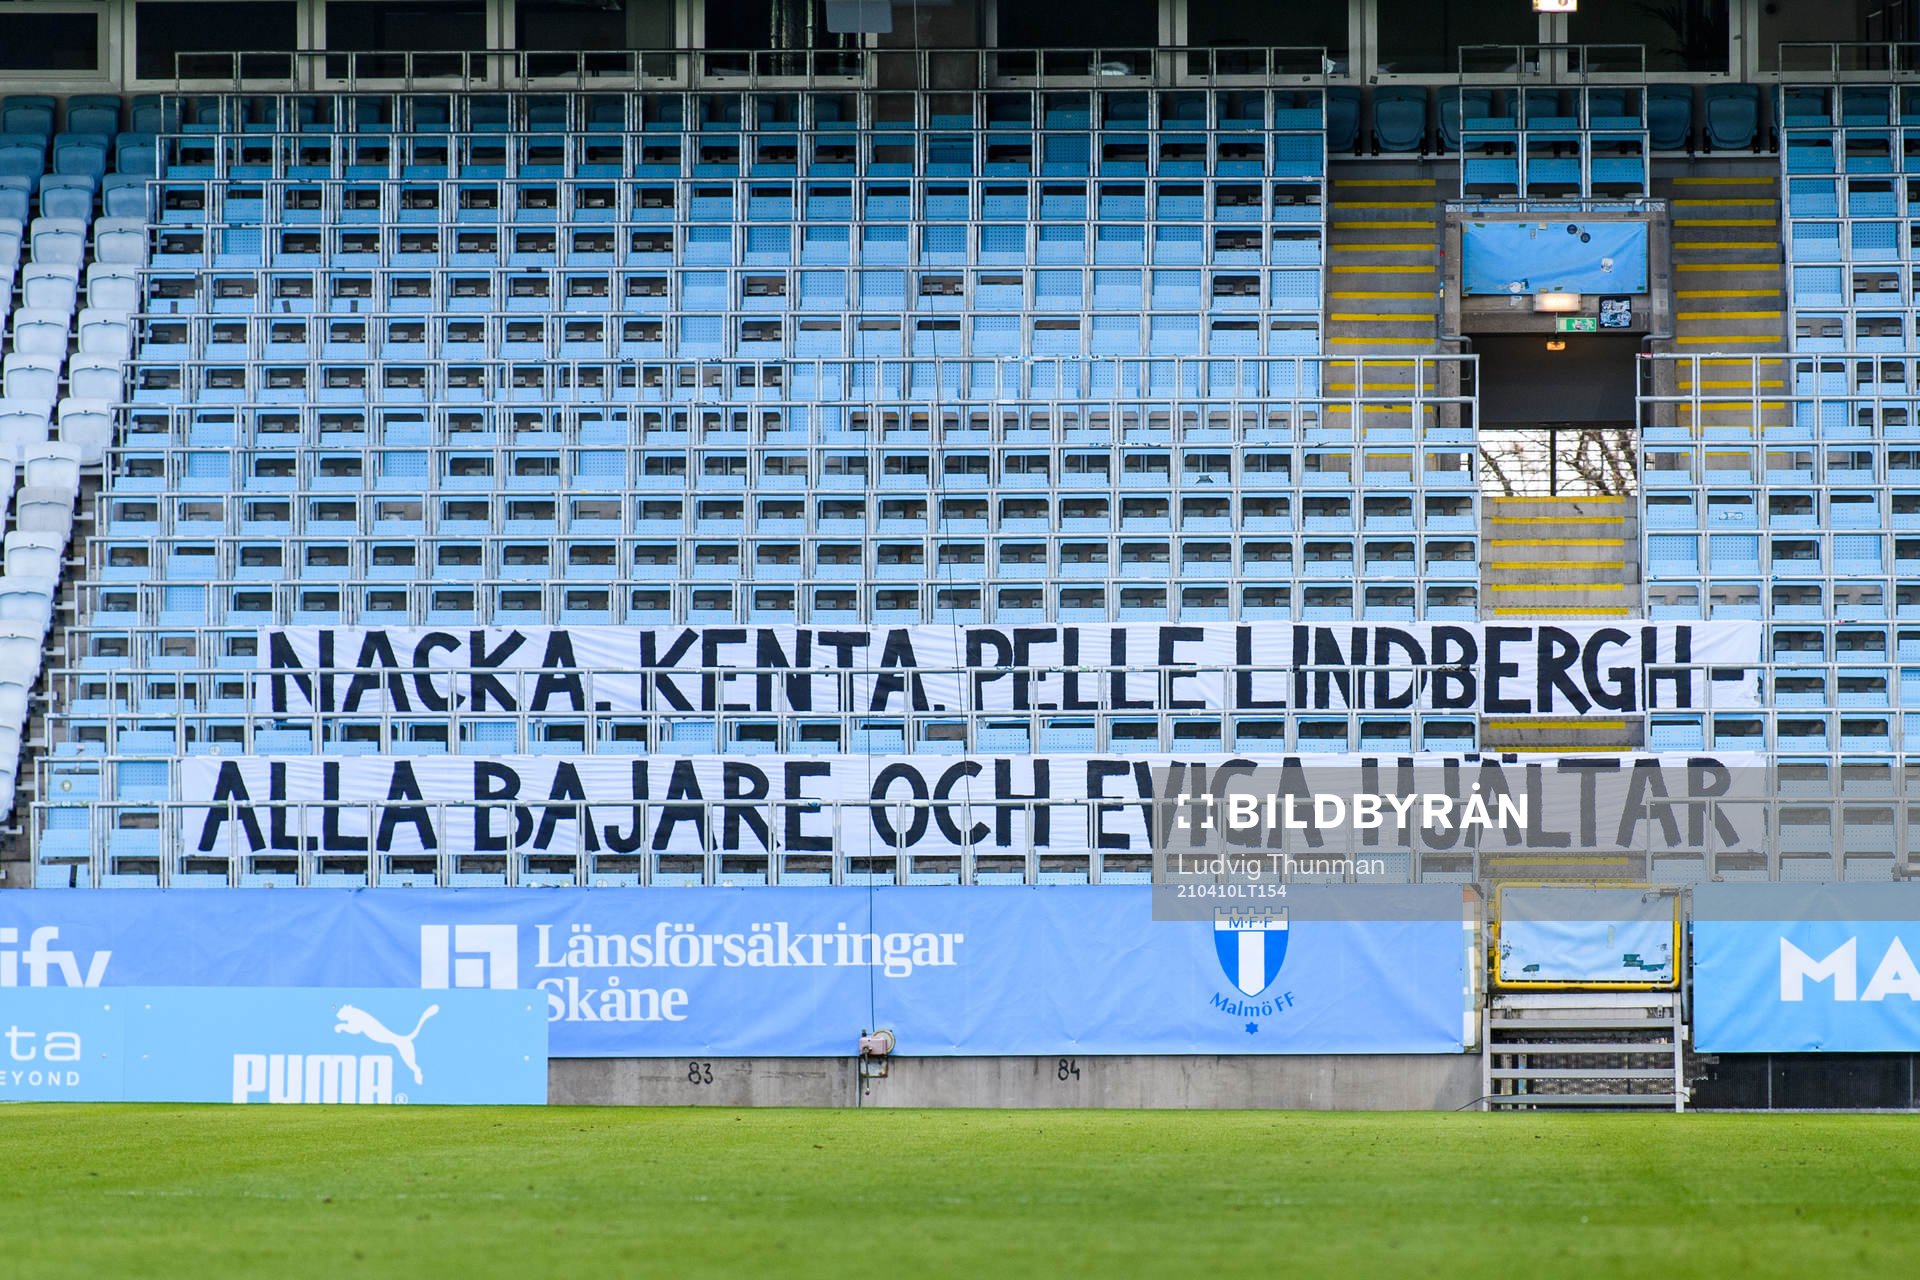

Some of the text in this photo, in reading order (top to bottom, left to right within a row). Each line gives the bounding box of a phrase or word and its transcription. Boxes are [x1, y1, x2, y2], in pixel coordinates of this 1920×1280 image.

[270, 629, 612, 714] NACKA.
[640, 627, 946, 714] KENTA.
[966, 627, 1208, 712] PELLE
[198, 760, 438, 853] ALLA
[473, 759, 833, 854] BAJARE
[871, 758, 1050, 848] OCH
[1087, 757, 1324, 850] EVIGA
[535, 921, 965, 978] Länsförsäkringar
[1780, 935, 1920, 1001] MA
[536, 976, 689, 1022] Skåne
[1210, 991, 1296, 1017] Malmö FF
[233, 1054, 393, 1103] PUMA
[688, 1062, 713, 1084] 83
[1058, 1059, 1081, 1081] 84
